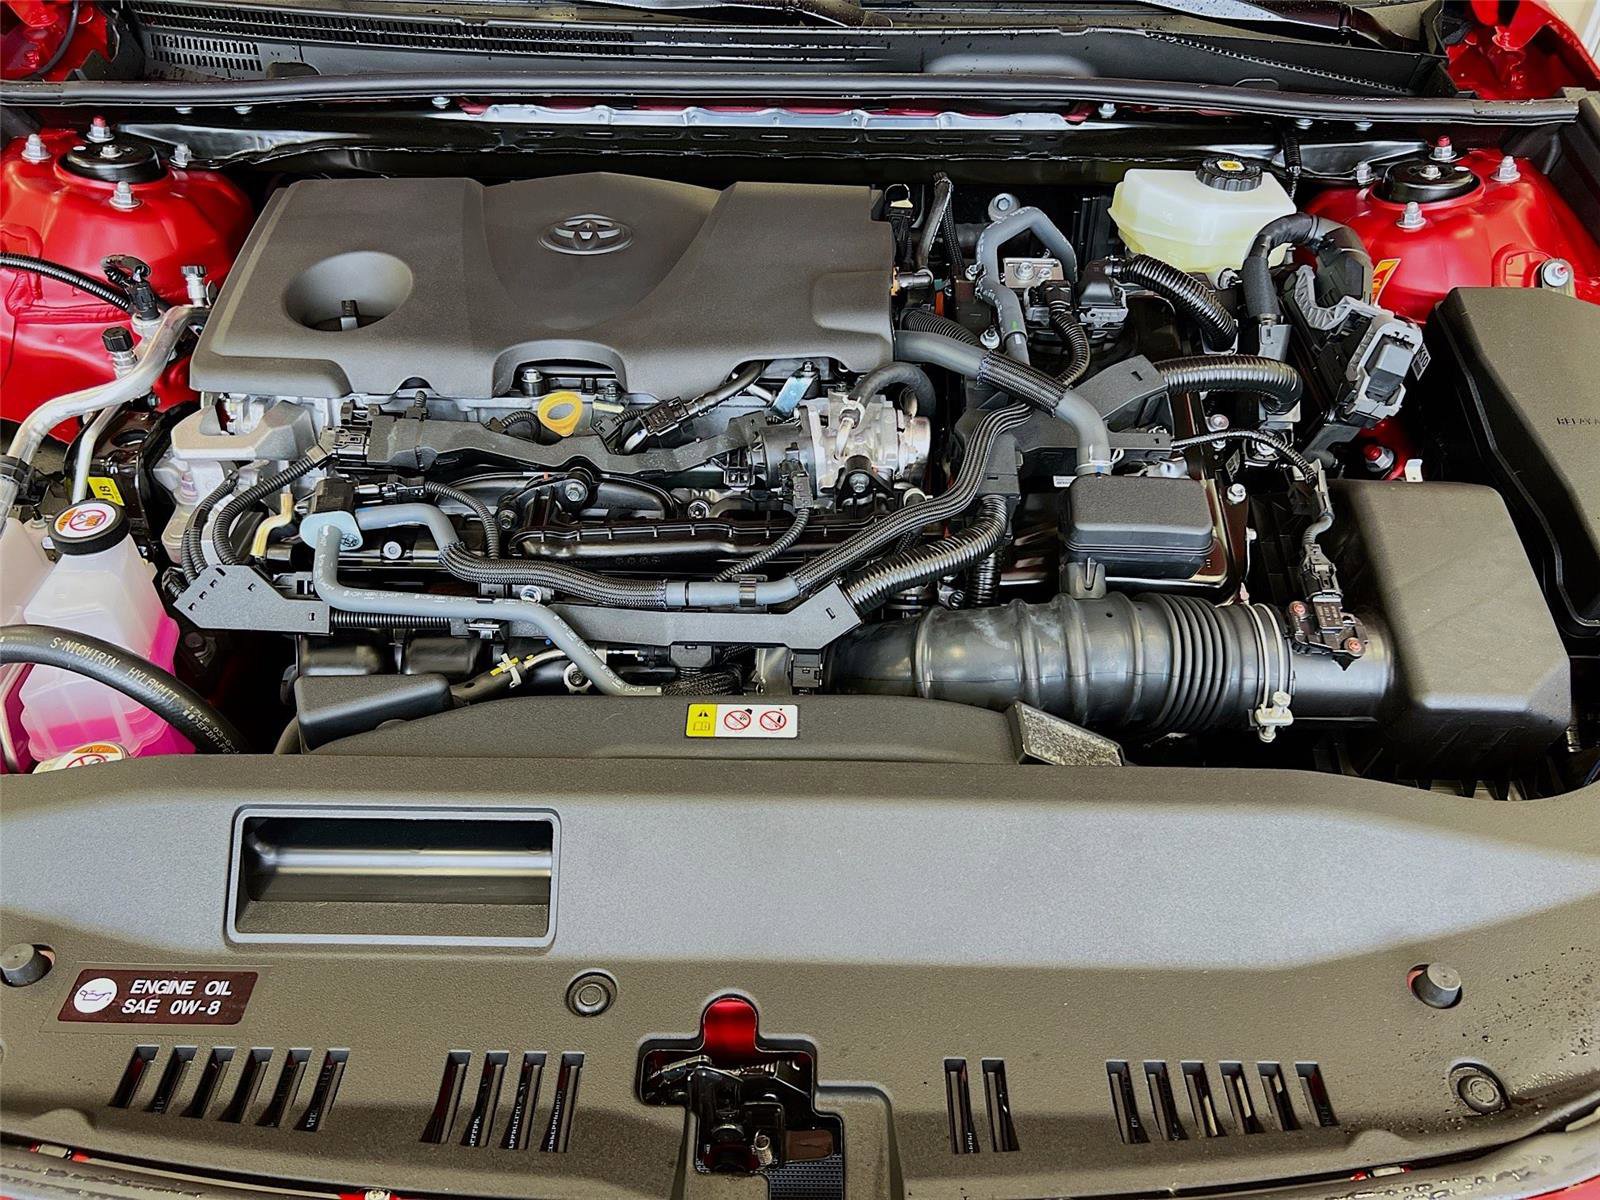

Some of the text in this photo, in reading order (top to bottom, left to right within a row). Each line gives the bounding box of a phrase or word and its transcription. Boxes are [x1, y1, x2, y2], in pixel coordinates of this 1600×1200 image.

[129, 979, 232, 996] ENGINE OIL
[121, 999, 221, 1016] SAE 0W-8
